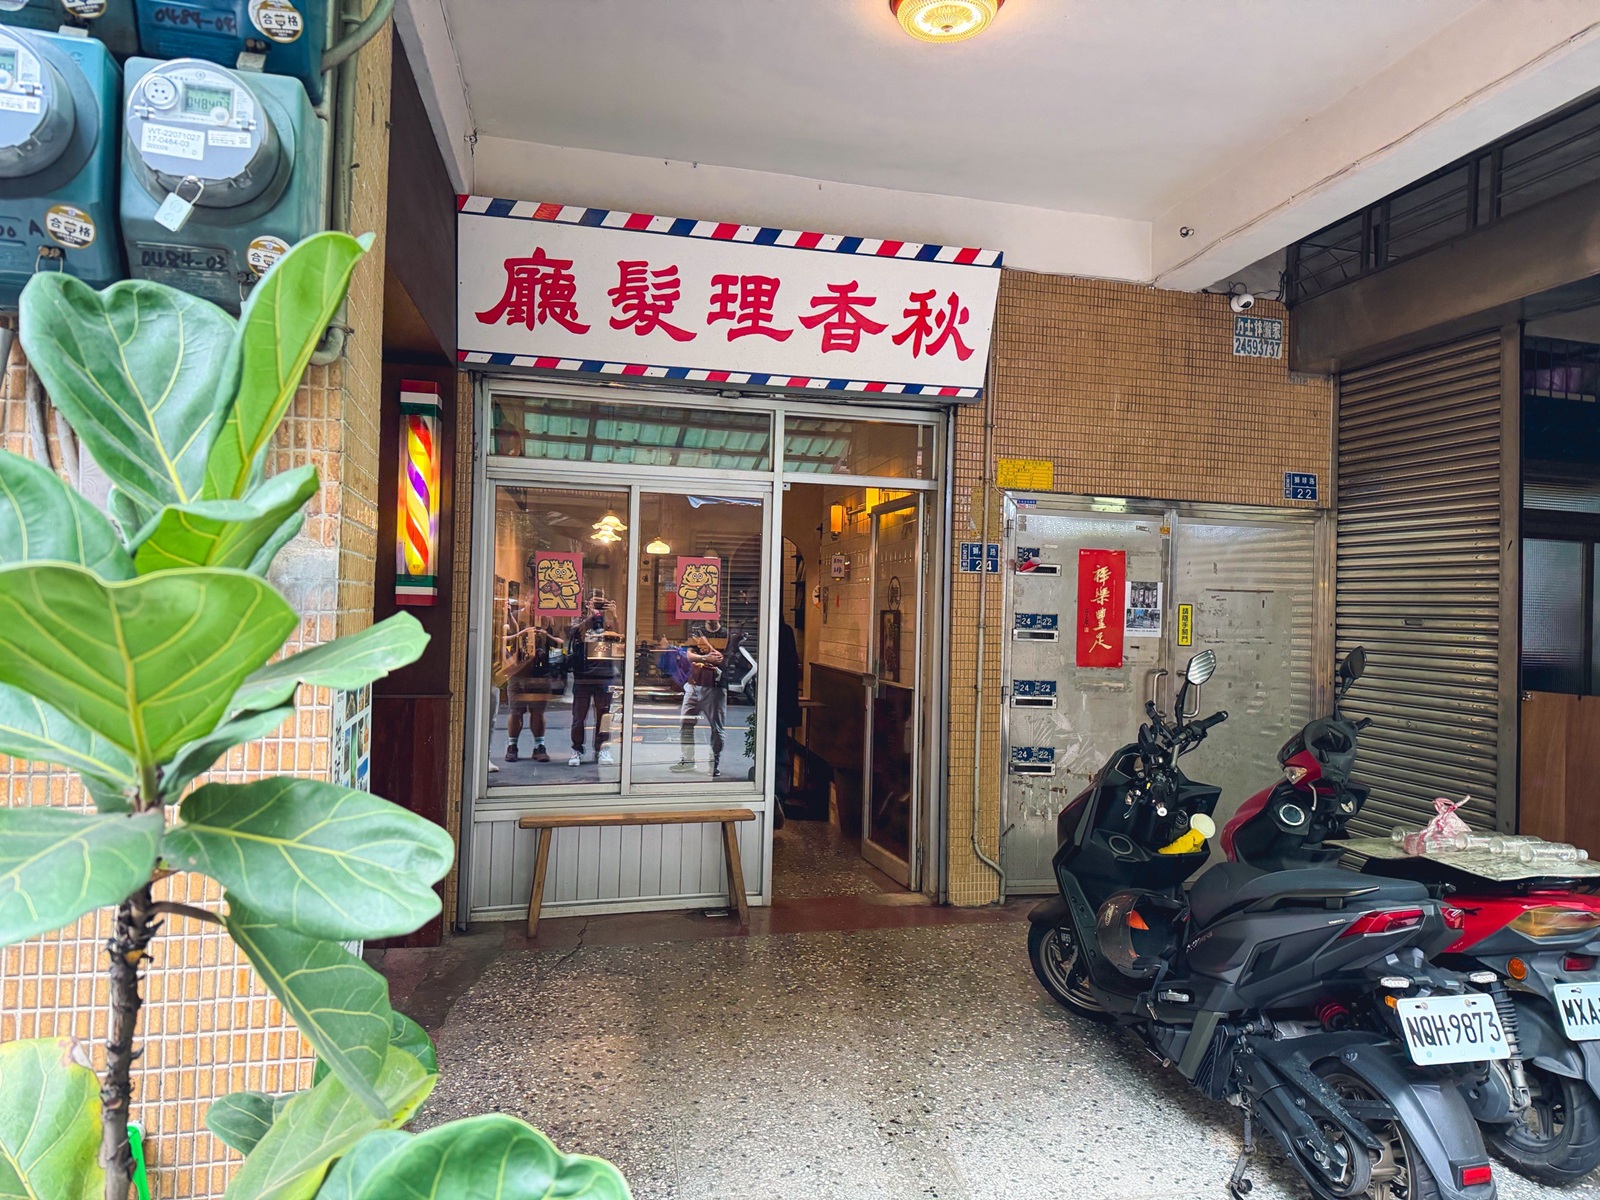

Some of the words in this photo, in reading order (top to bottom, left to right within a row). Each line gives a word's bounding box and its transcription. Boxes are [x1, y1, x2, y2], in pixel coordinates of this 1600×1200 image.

[148, 135, 189, 147] 17-0484-03
[141, 250, 227, 269] 0484-03
[475, 247, 976, 362] 秋香理髮廳
[1235, 338, 1280, 357] 24593737
[1297, 488, 1312, 499] 22
[1023, 551, 1033, 559] 24
[975, 560, 992, 571] 24
[1021, 617, 1031, 625] 24
[1042, 618, 1052, 626] 22
[1019, 684, 1030, 692] 24
[1040, 684, 1051, 692] 22
[1017, 750, 1028, 758] 24
[1039, 750, 1050, 759] 22
